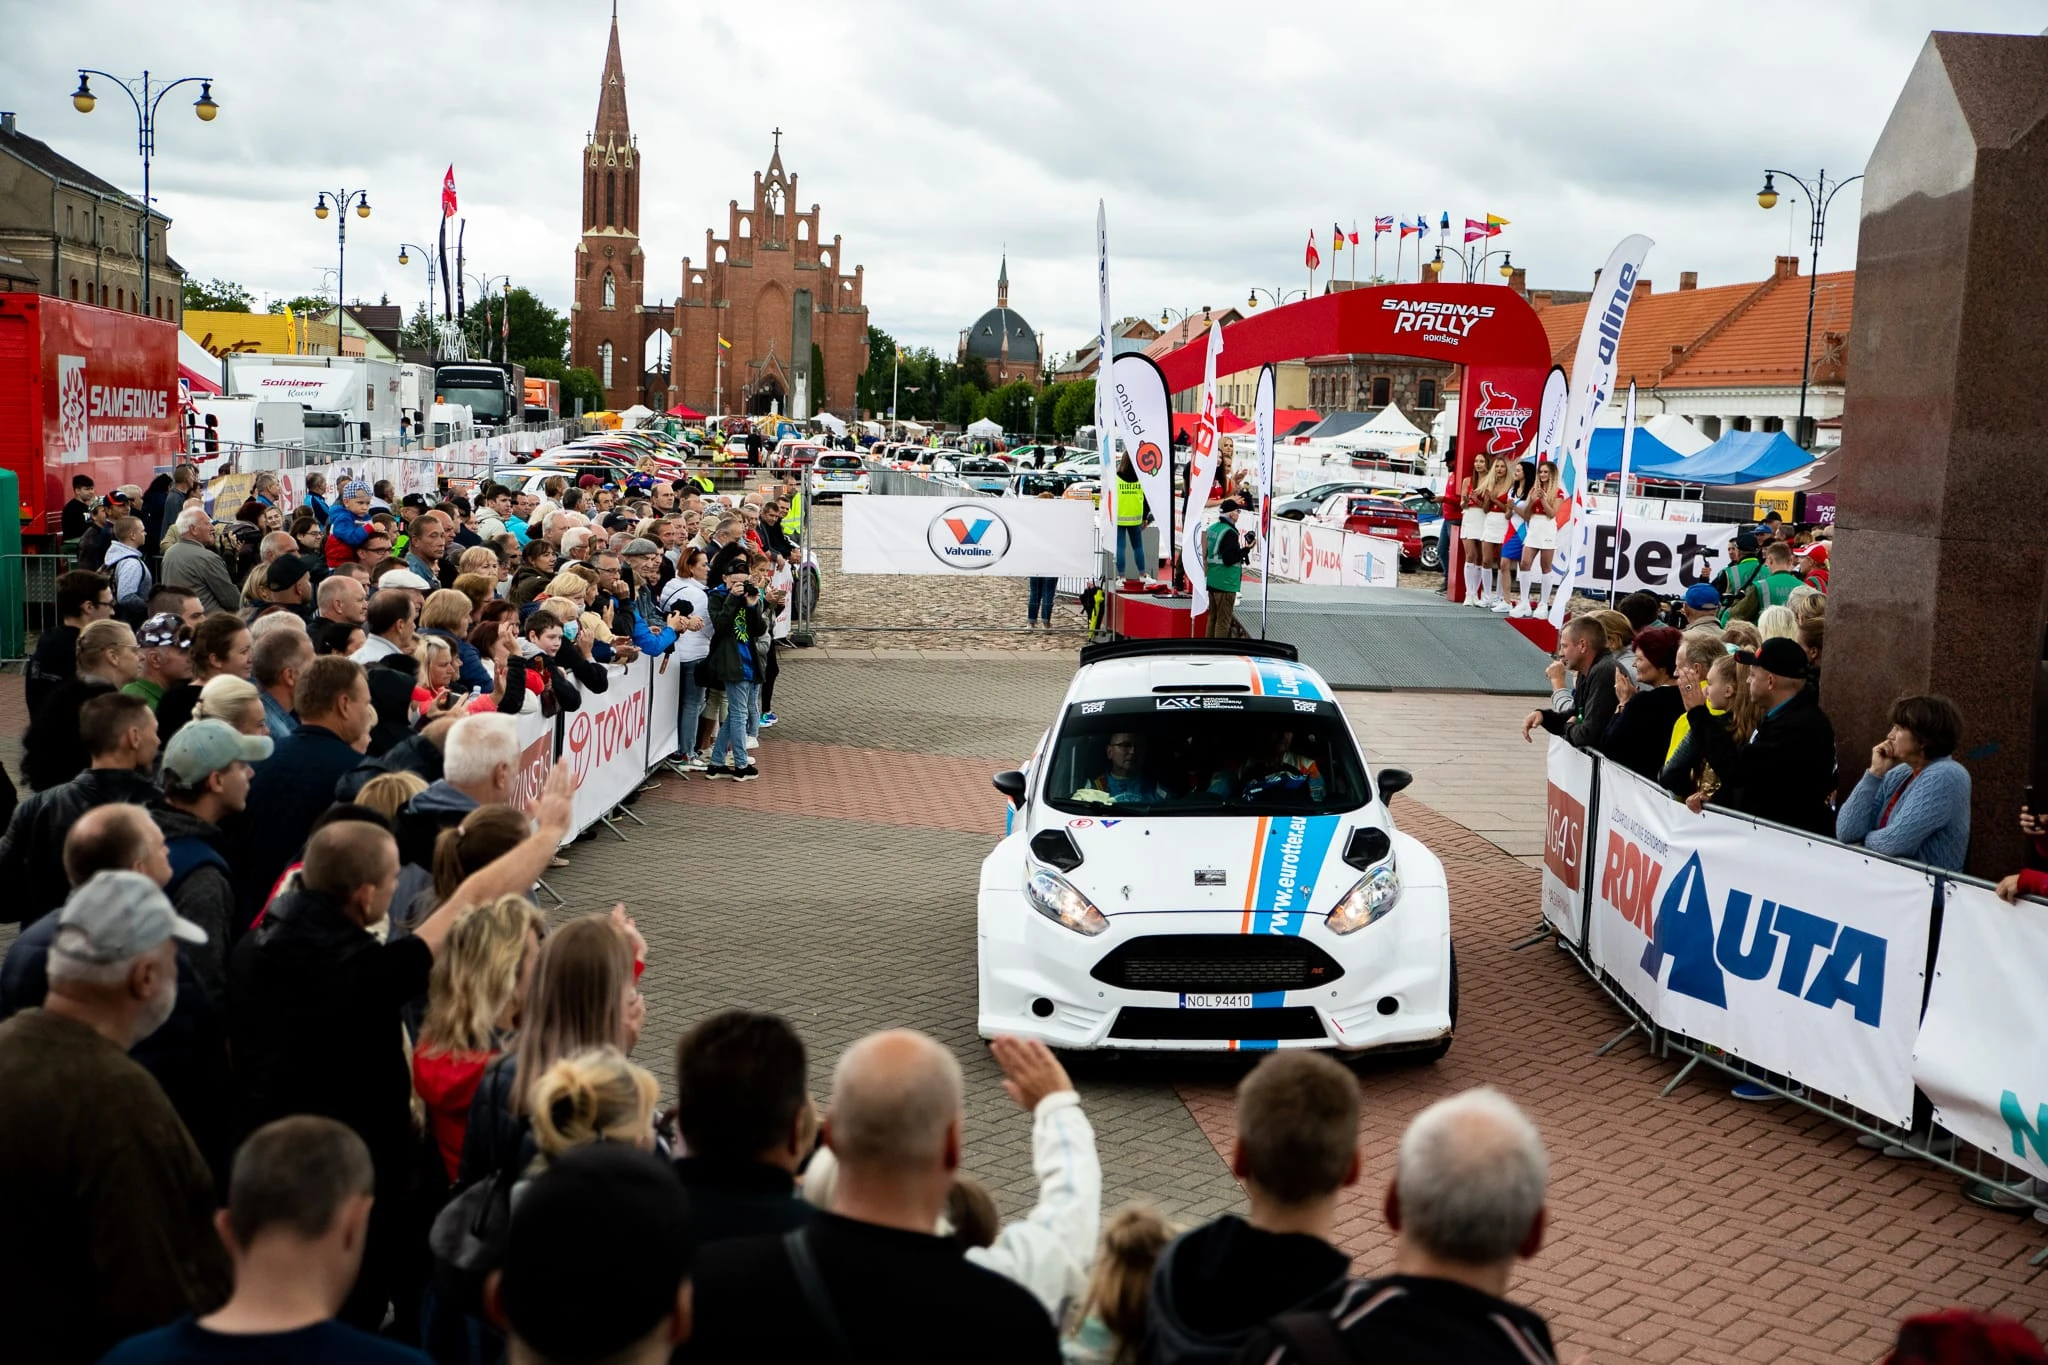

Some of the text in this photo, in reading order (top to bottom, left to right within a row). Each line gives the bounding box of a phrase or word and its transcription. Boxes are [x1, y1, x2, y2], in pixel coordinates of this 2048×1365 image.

[1382, 298, 1496, 318] SAMSONAS
[1393, 312, 1480, 337] RALLY
[1423, 333, 1459, 346] ROKIŠKIS
[261, 378, 329, 387] Soininen
[288, 389, 319, 398] Racing
[90, 385, 168, 419] SAMSONAS
[1479, 408, 1533, 418] SAMSONAS
[1483, 416, 1527, 429] RALLY
[90, 425, 149, 442] MOTORSPORT
[945, 546, 992, 556] Valvoline
[1315, 550, 1342, 571] VIADA
[595, 687, 646, 768] TOYOTA
[1187, 995, 1250, 1007] NOL 94410
